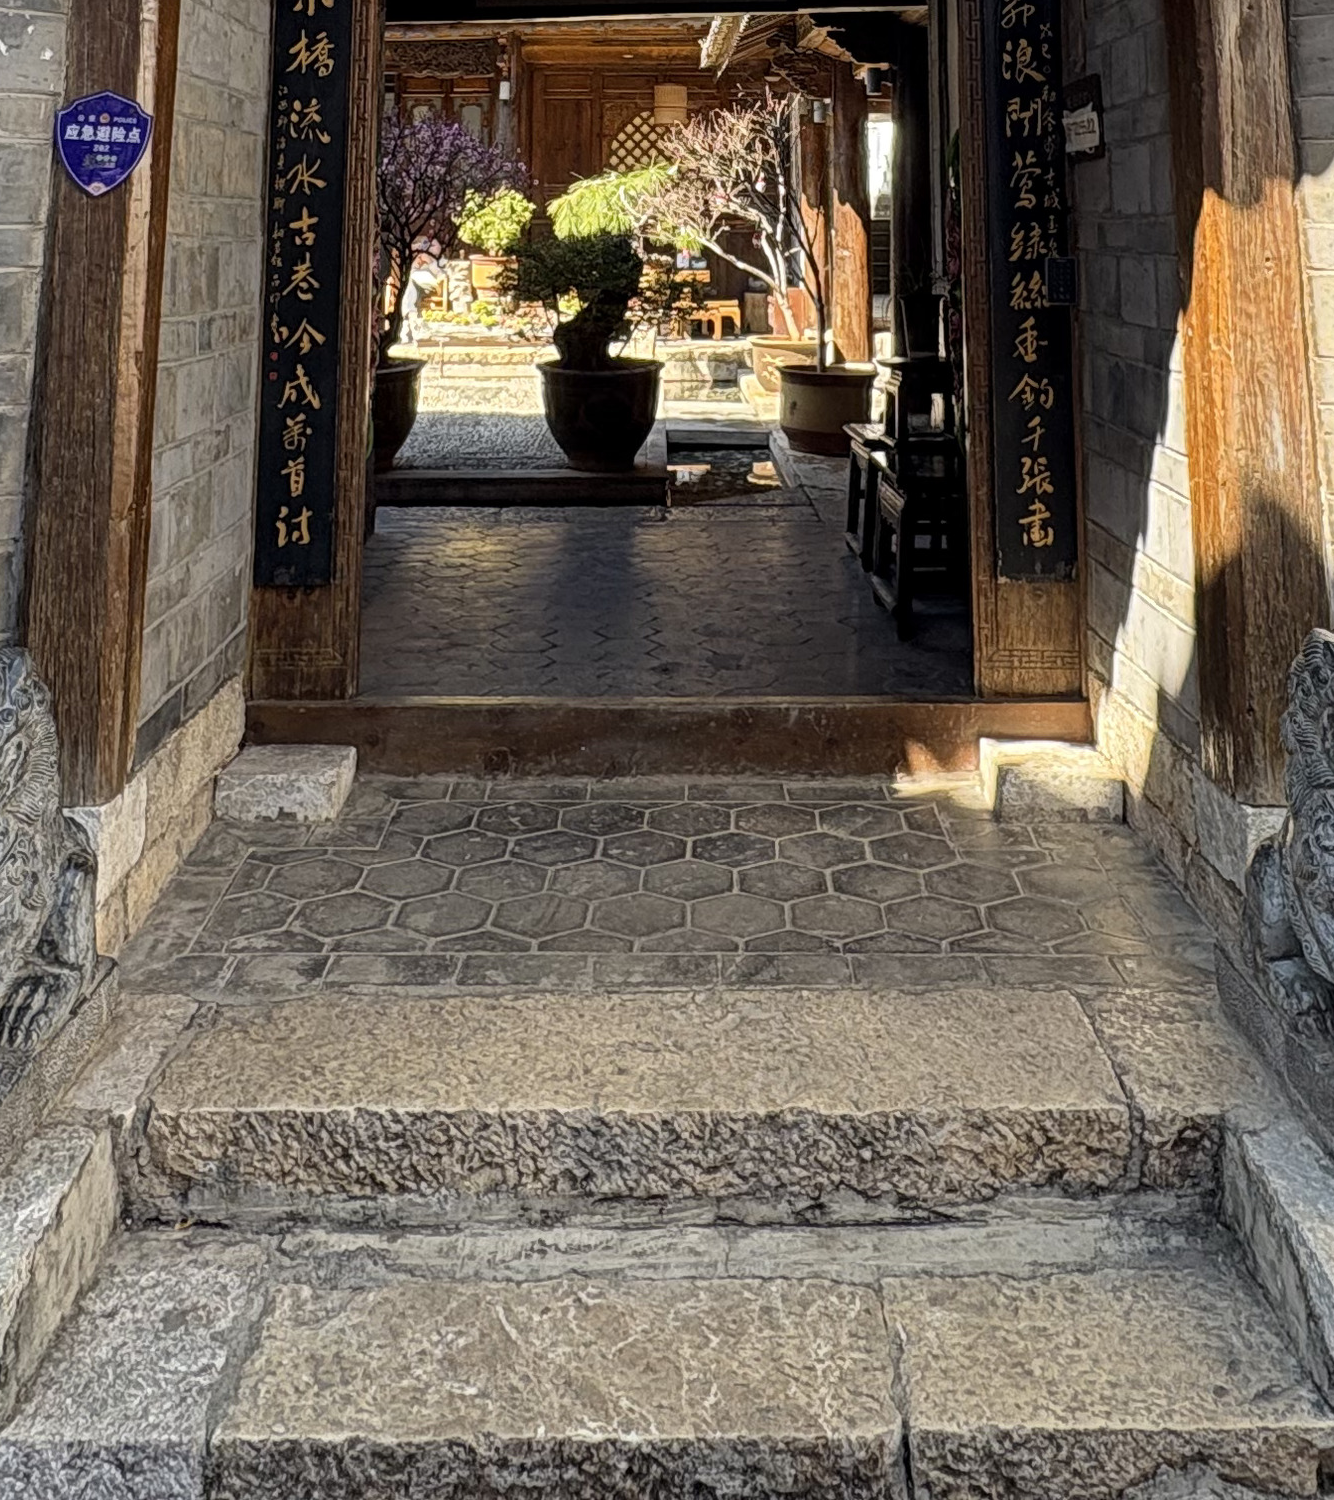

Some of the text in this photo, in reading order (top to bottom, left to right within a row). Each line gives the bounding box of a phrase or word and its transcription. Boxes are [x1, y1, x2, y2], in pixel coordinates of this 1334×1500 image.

[64, 124, 142, 143] 应急避险点
